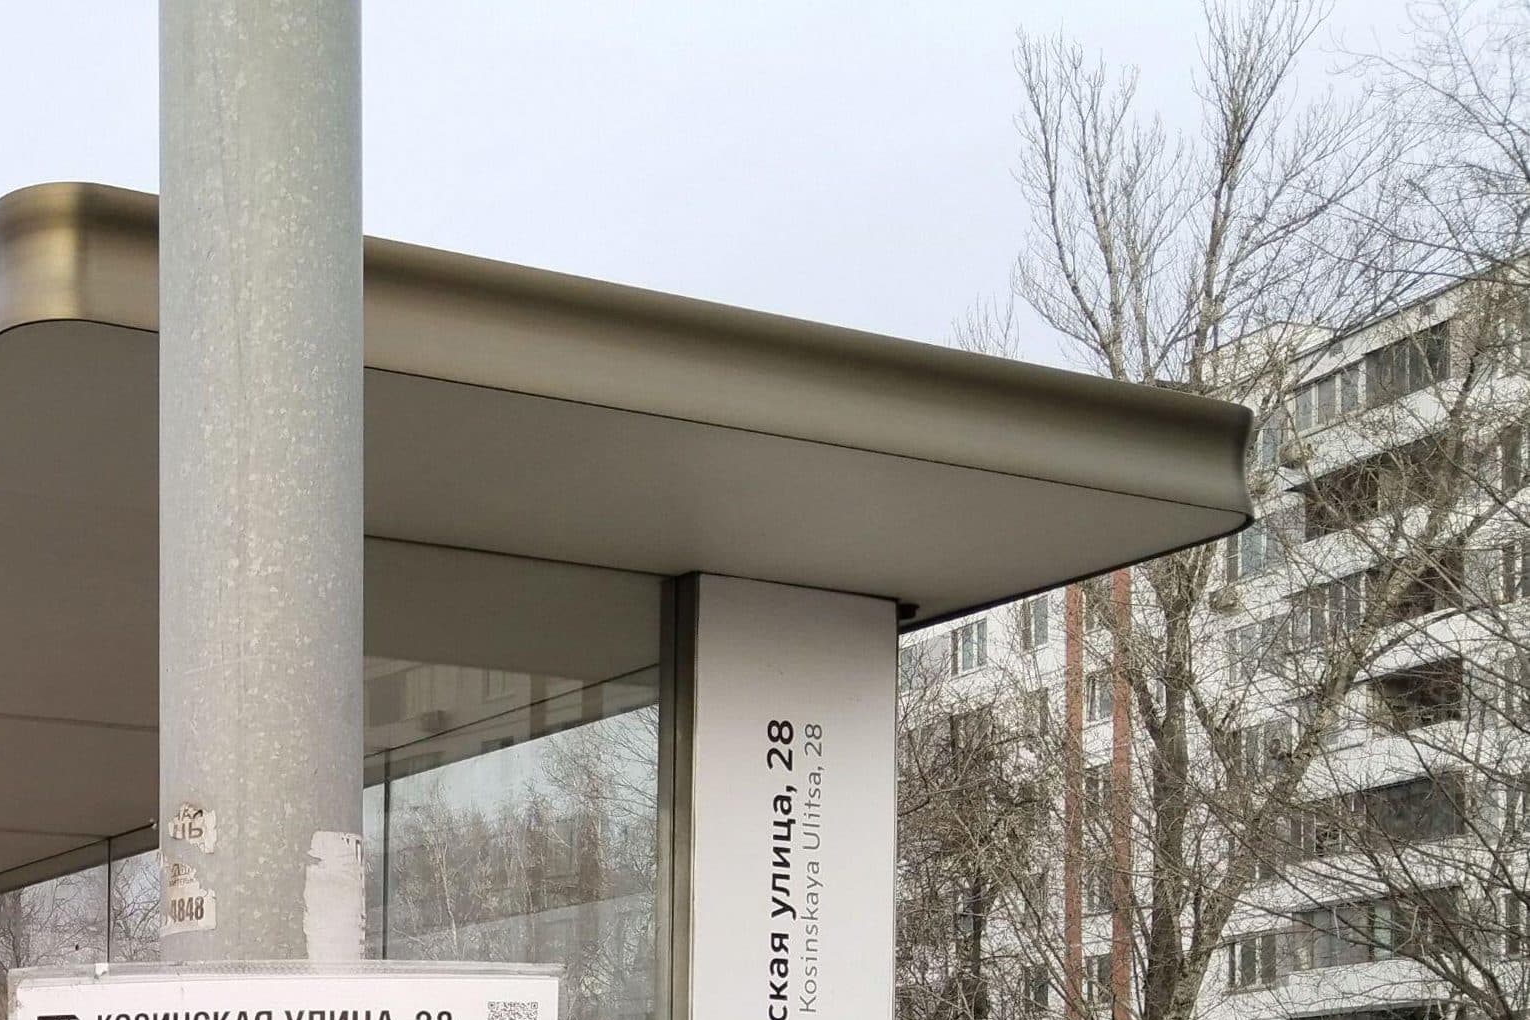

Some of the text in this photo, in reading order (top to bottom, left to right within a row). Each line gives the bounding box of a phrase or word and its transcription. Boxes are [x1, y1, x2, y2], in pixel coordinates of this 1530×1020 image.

[767, 719, 794, 771] 28
[772, 784, 797, 921] улица,
[800, 723, 826, 1013] Kosinskaya Ulitsa, 28
